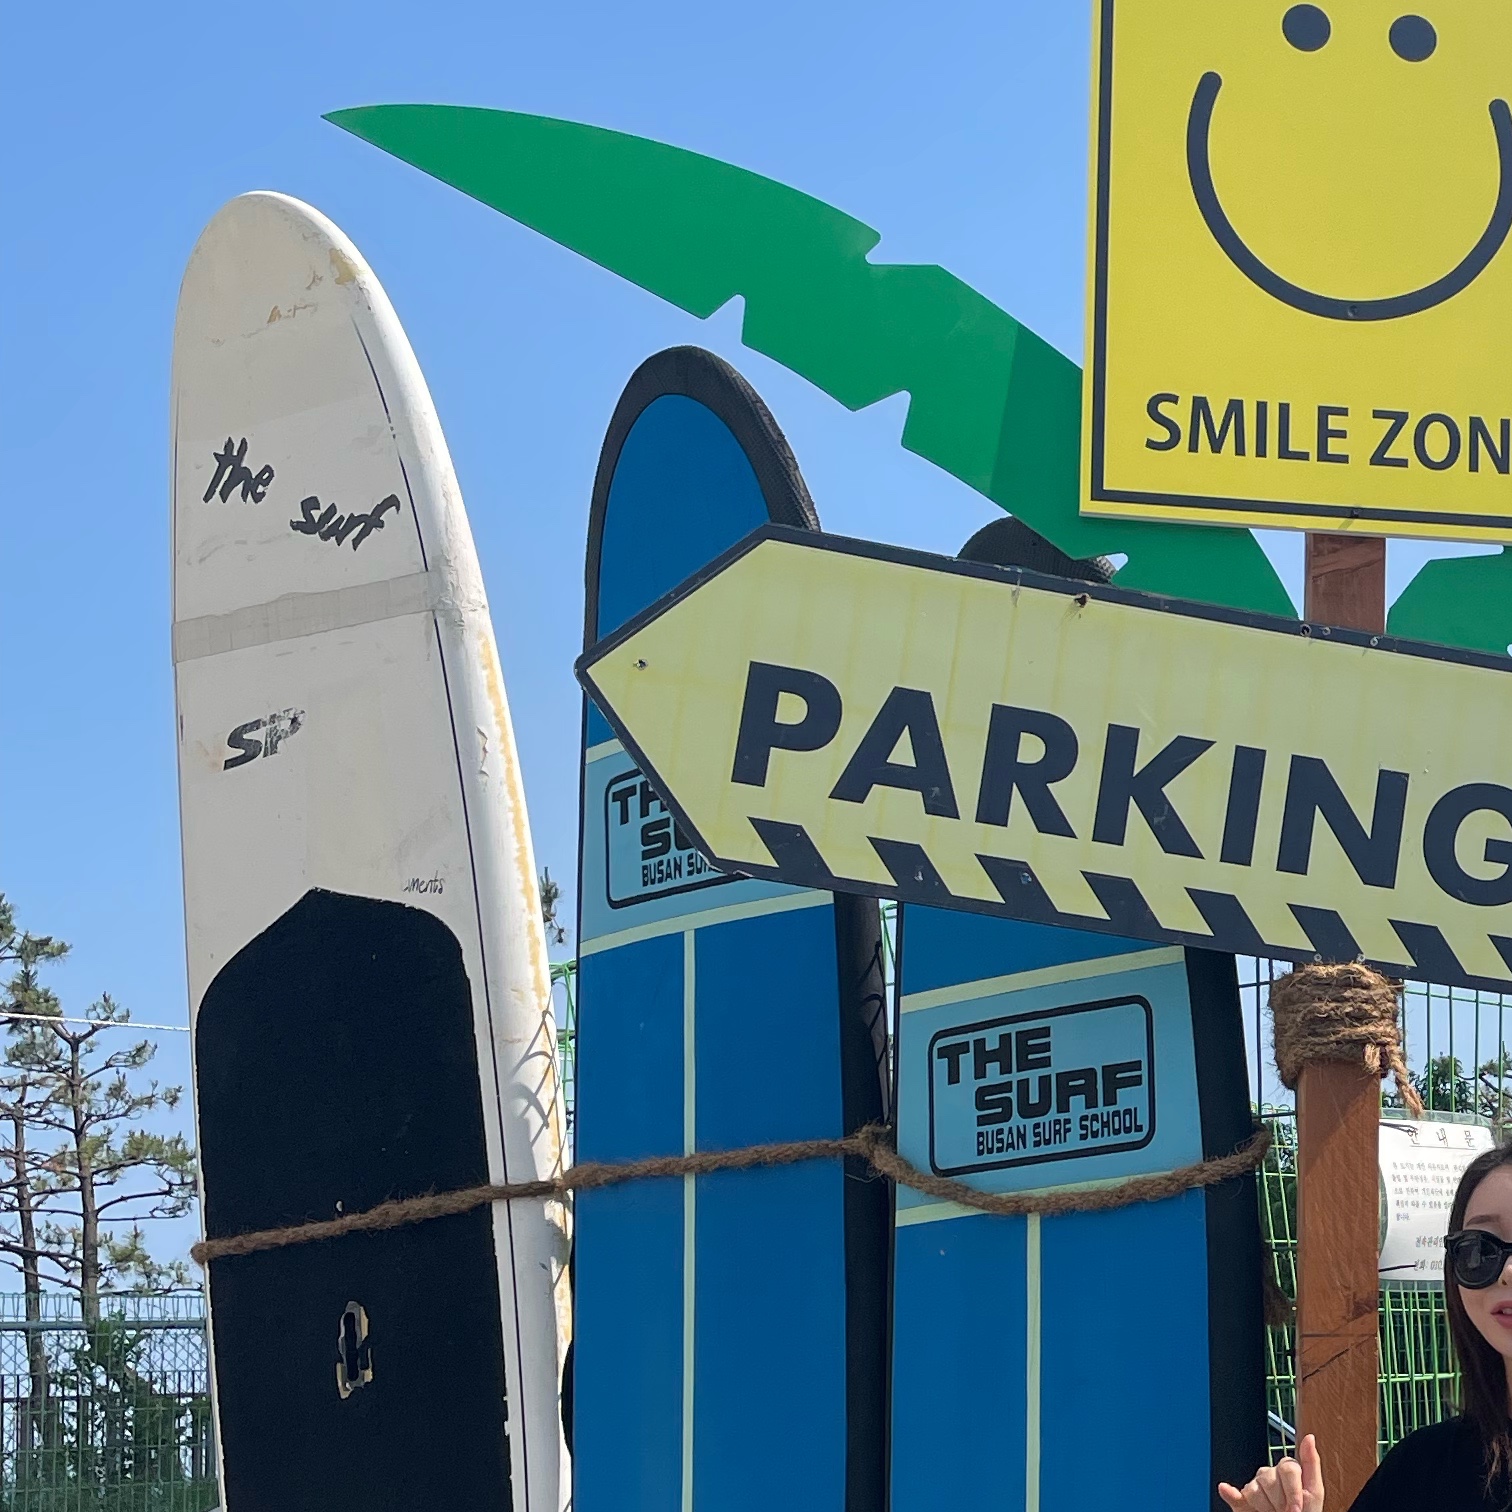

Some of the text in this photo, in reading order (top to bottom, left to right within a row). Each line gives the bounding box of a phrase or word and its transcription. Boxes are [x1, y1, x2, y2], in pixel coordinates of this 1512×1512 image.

[1144, 392, 1350, 465] SMILE
[202, 436, 275, 504] the
[290, 493, 401, 552] surf
[611, 780, 670, 826] TH
[641, 855, 683, 888] BUSAN
[936, 1025, 1052, 1086] THE
[974, 1059, 1143, 1128] SURF
[976, 1106, 1144, 1157] BUSAN SURF SCHOOL
